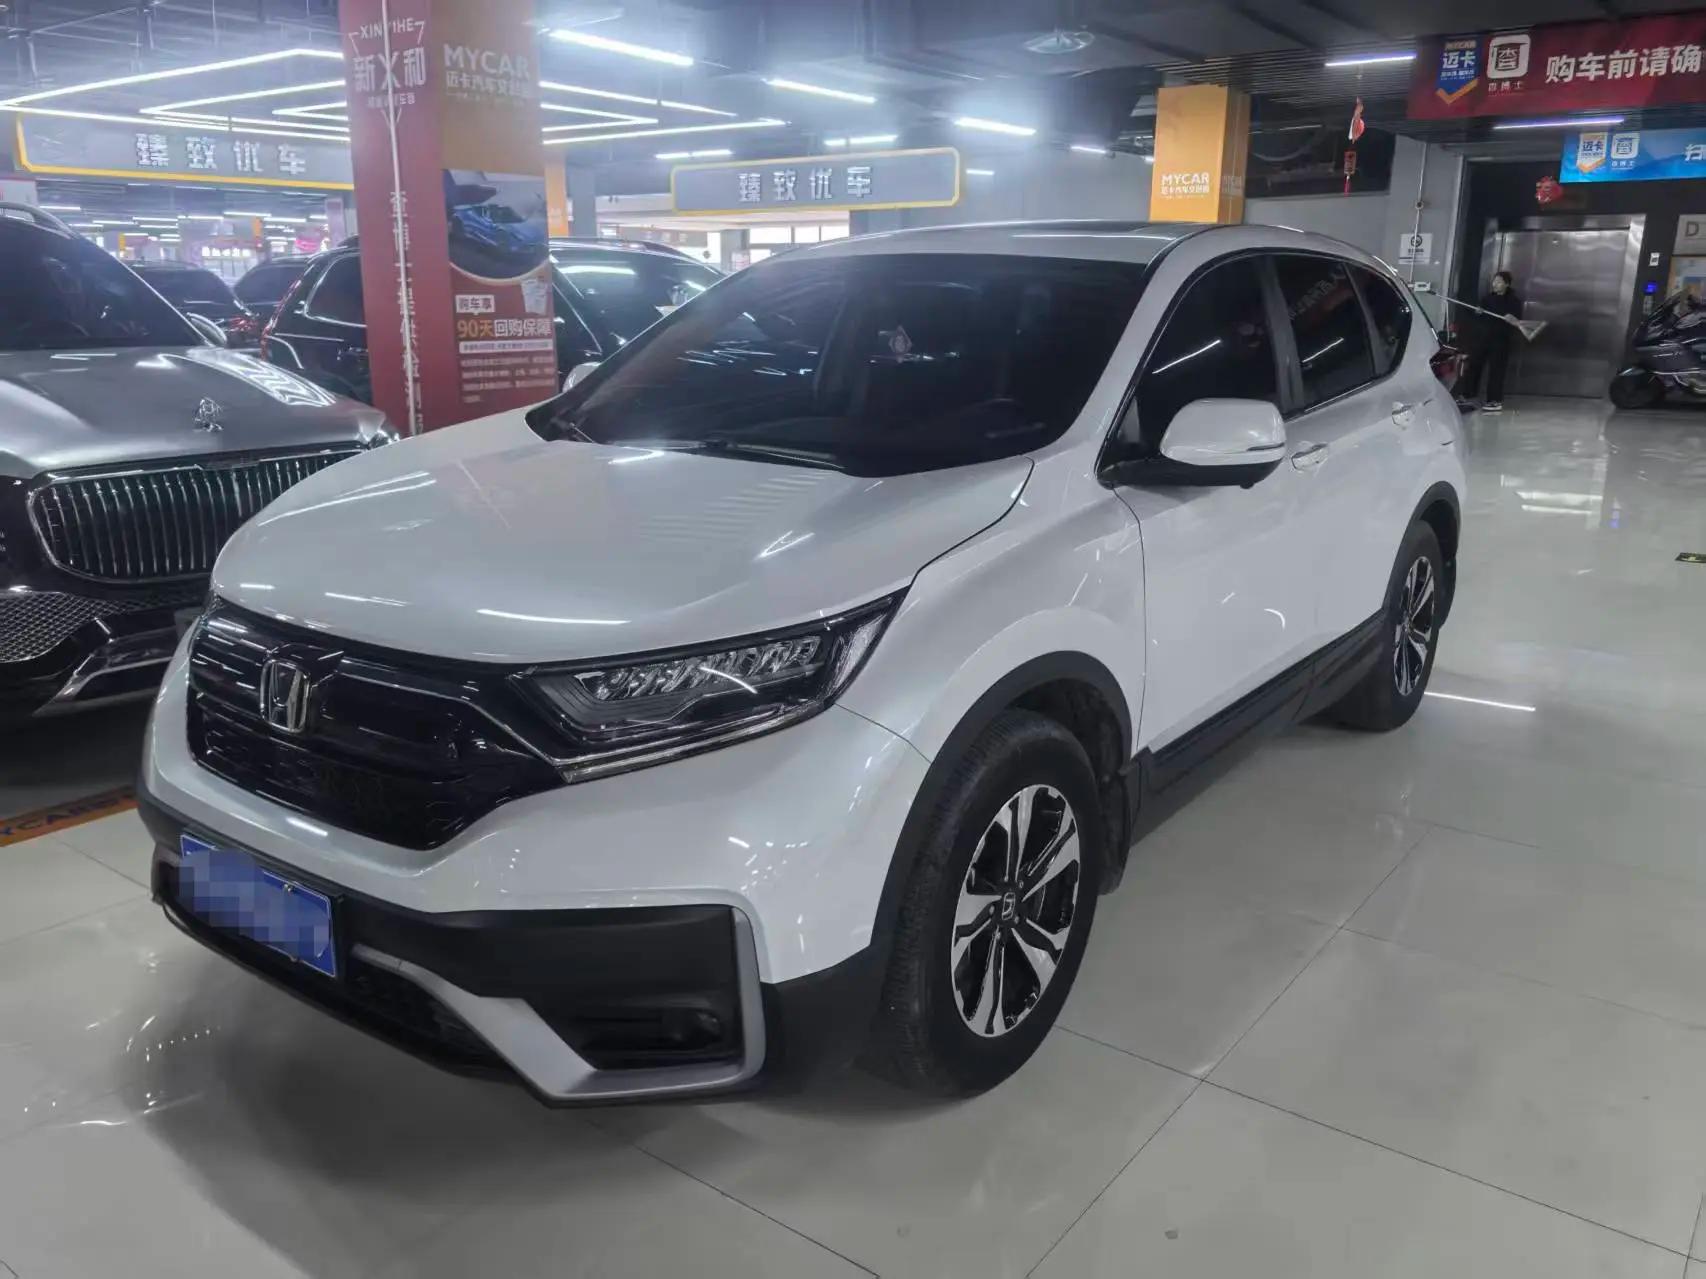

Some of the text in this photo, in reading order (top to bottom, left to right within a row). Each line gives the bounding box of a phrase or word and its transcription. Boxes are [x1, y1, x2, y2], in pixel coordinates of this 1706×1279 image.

[359, 17, 414, 39] XINIHE
[443, 43, 530, 81] MYCAR
[1442, 51, 1476, 69] 迈卡
[1545, 44, 1703, 84] 购车前请确
[1582, 140, 1603, 152] 迈卡
[738, 166, 872, 202] 臻致优车
[1161, 172, 1210, 185] MYCAR
[456, 317, 552, 338] 90天回购保障
